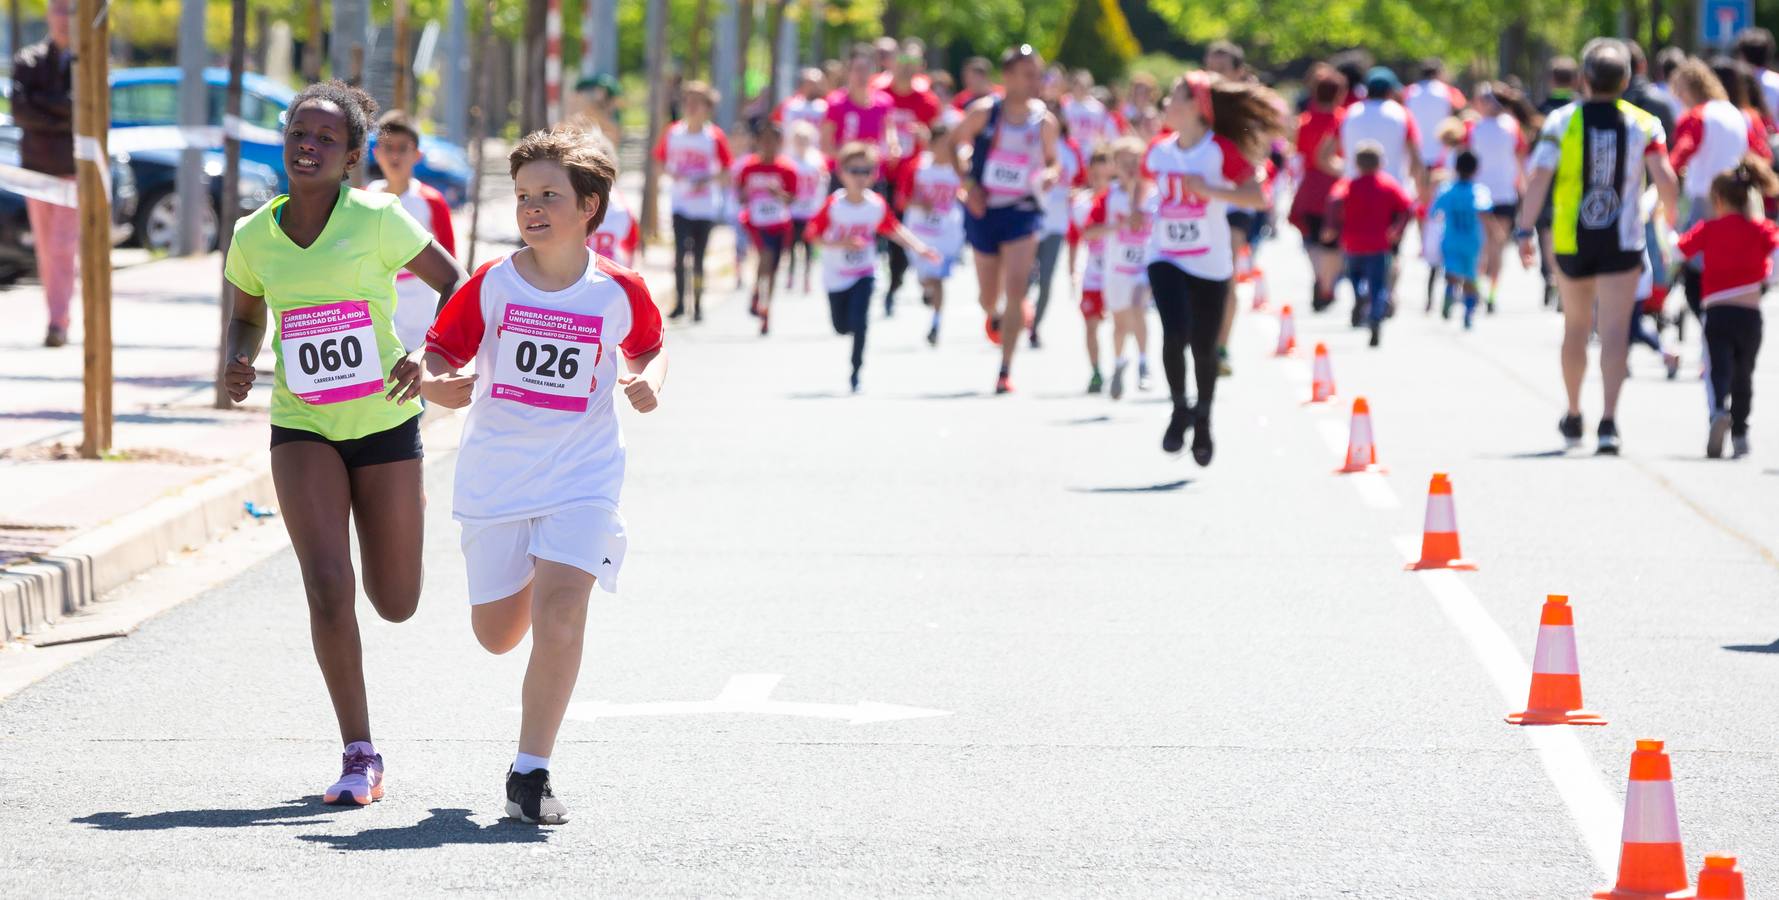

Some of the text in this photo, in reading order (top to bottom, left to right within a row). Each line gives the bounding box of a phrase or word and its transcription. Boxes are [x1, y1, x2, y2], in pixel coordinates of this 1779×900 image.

[1167, 221, 1200, 242] 025
[285, 309, 340, 322] CARRERA CAMPUS
[285, 318, 327, 328] UNIVERSIDAD
[510, 310, 573, 323] CARRERA CAMPUS
[509, 316, 556, 327] UNIVERSIDAD
[578, 326, 597, 334] RIOJA
[299, 336, 362, 375] 060
[516, 341, 580, 379] 026
[522, 377, 543, 385] CARRERA
